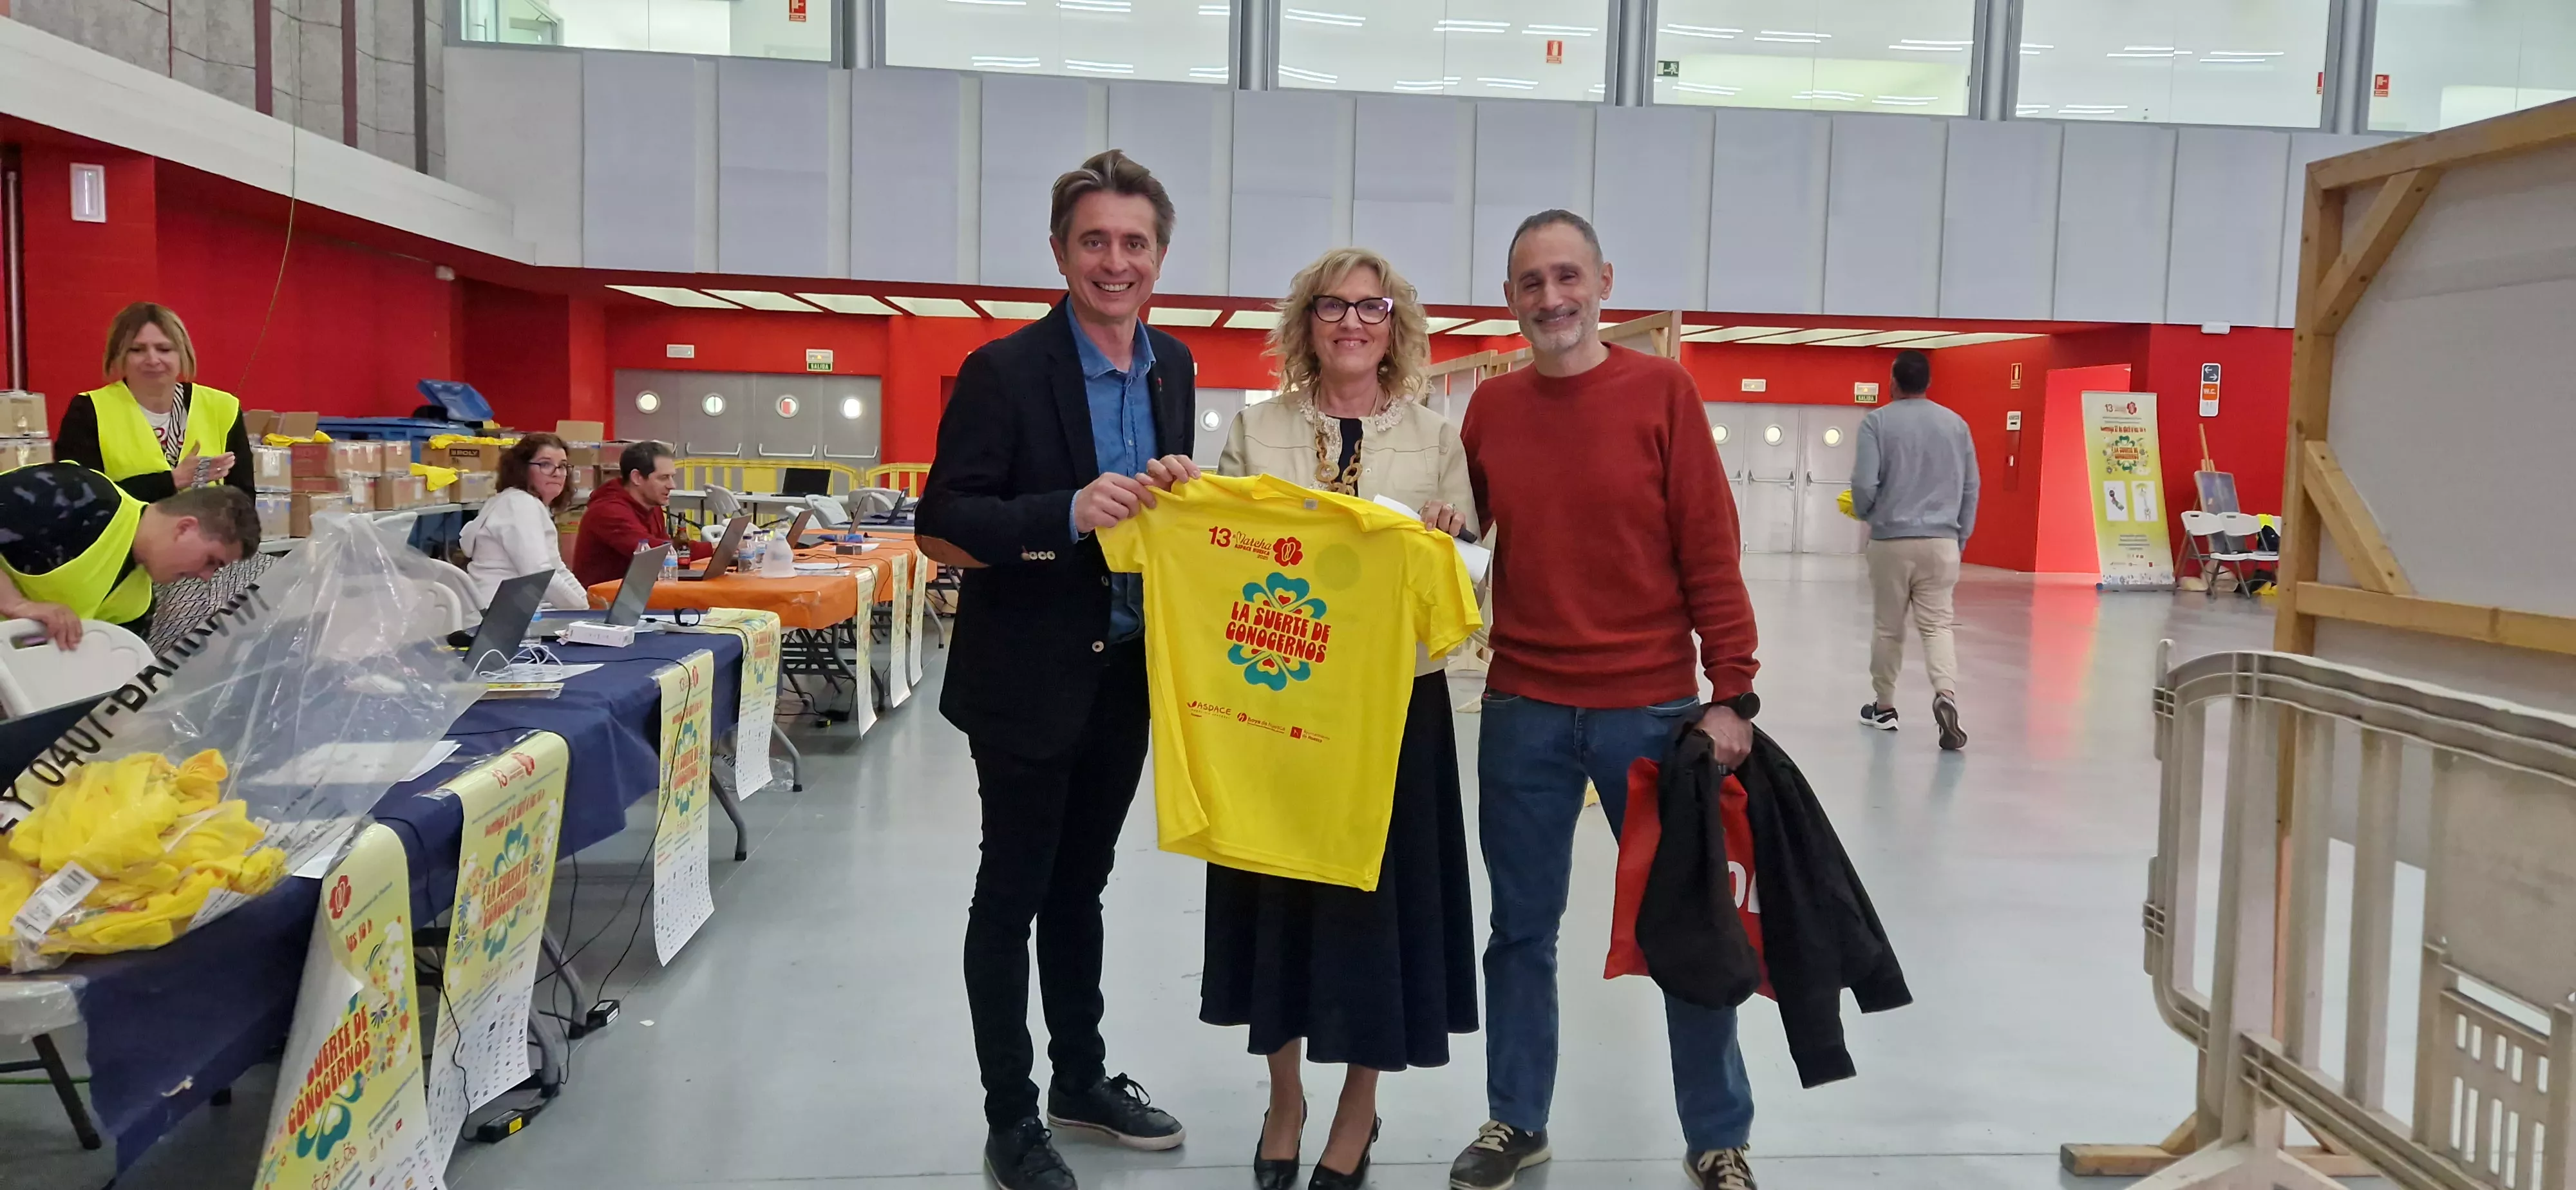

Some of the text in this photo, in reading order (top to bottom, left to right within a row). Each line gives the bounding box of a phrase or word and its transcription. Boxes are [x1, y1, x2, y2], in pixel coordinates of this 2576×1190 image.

[1236, 531, 1273, 551] Marcha
[1231, 601, 1332, 644] LA SUERTE DE
[352, 1005, 368, 1039] DE
